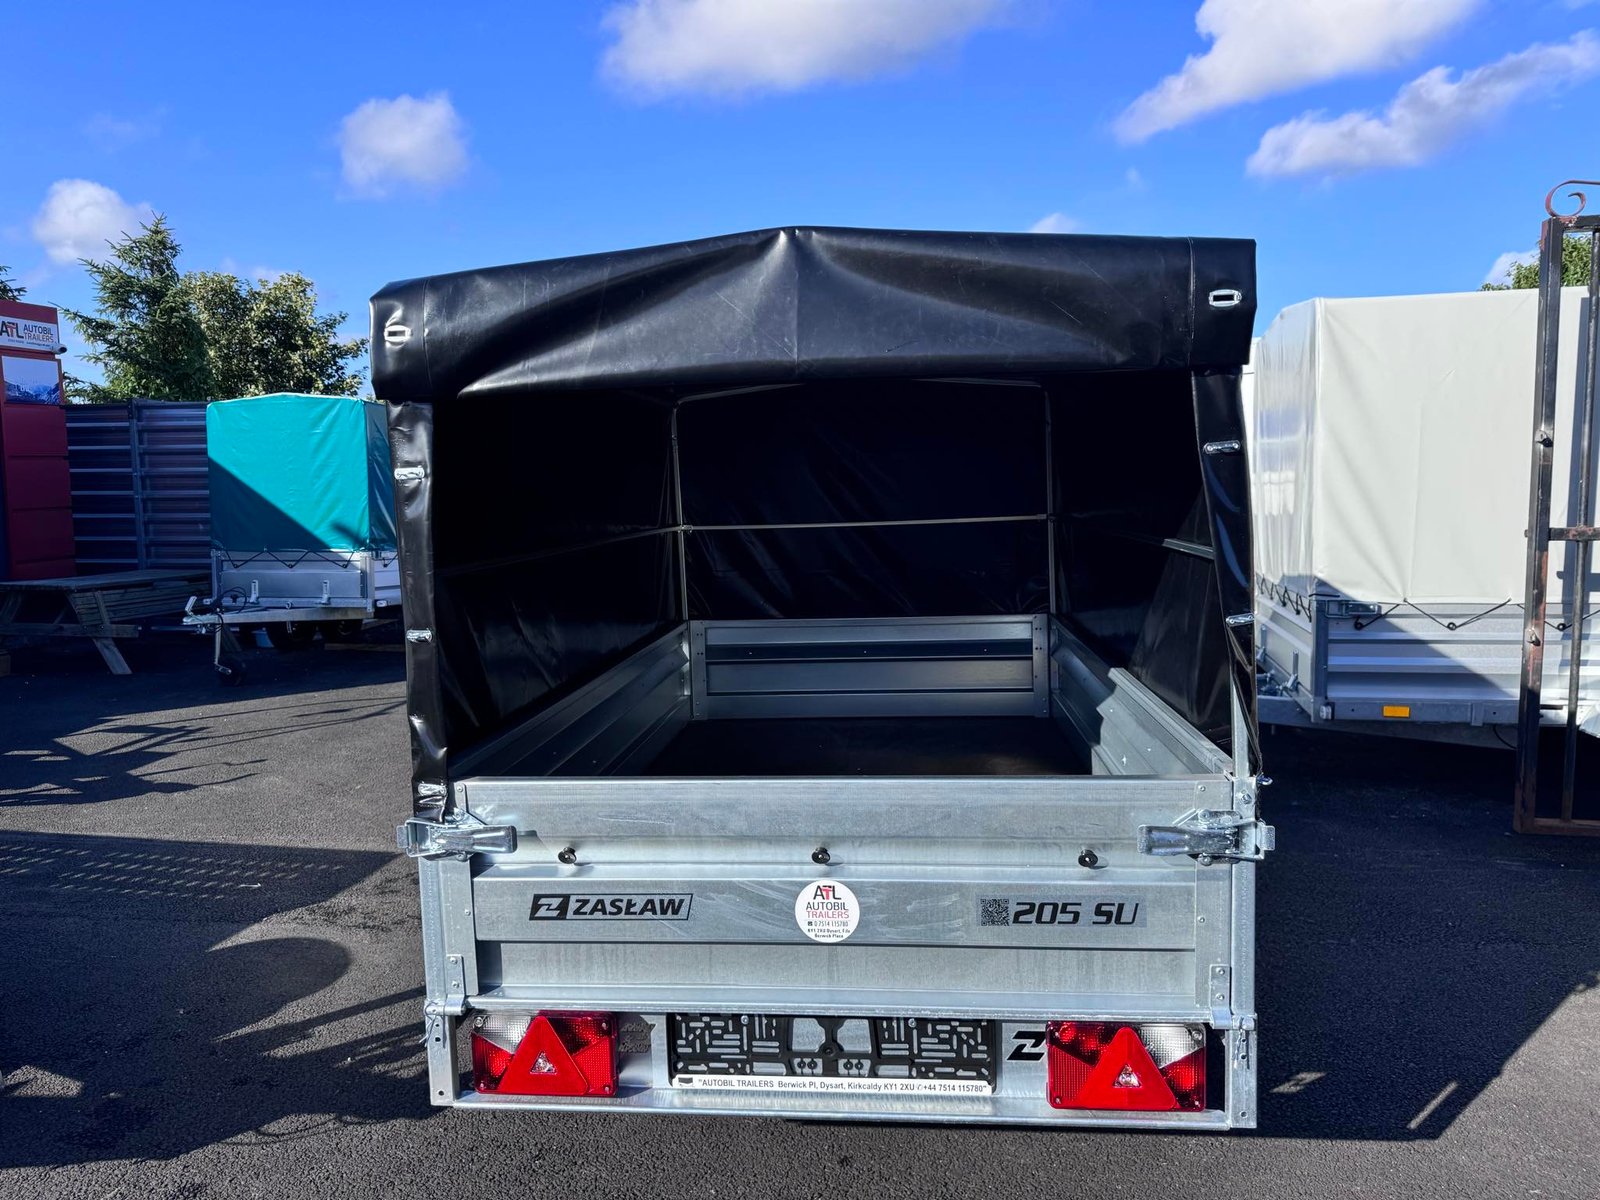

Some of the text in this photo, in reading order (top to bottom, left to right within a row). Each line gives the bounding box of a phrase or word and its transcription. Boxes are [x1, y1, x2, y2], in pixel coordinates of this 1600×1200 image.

[23, 323, 54, 335] AUTOBIL
[24, 332, 54, 343] TRAILERS
[813, 885, 842, 900] ATL
[572, 898, 685, 916] ZASŁAW
[806, 902, 849, 911] AUTOBIL
[807, 911, 850, 919] TRAILERS
[1012, 902, 1139, 925] 205 SU
[737, 1079, 774, 1088] TRAILERS
[778, 1080, 807, 1089] Berwick
[820, 1082, 846, 1090] Dysart,
[847, 1082, 882, 1091] Kirkcaldy
[883, 1083, 898, 1091] KY1
[899, 1083, 915, 1091] 2XU
[938, 1084, 956, 1092] 7514
